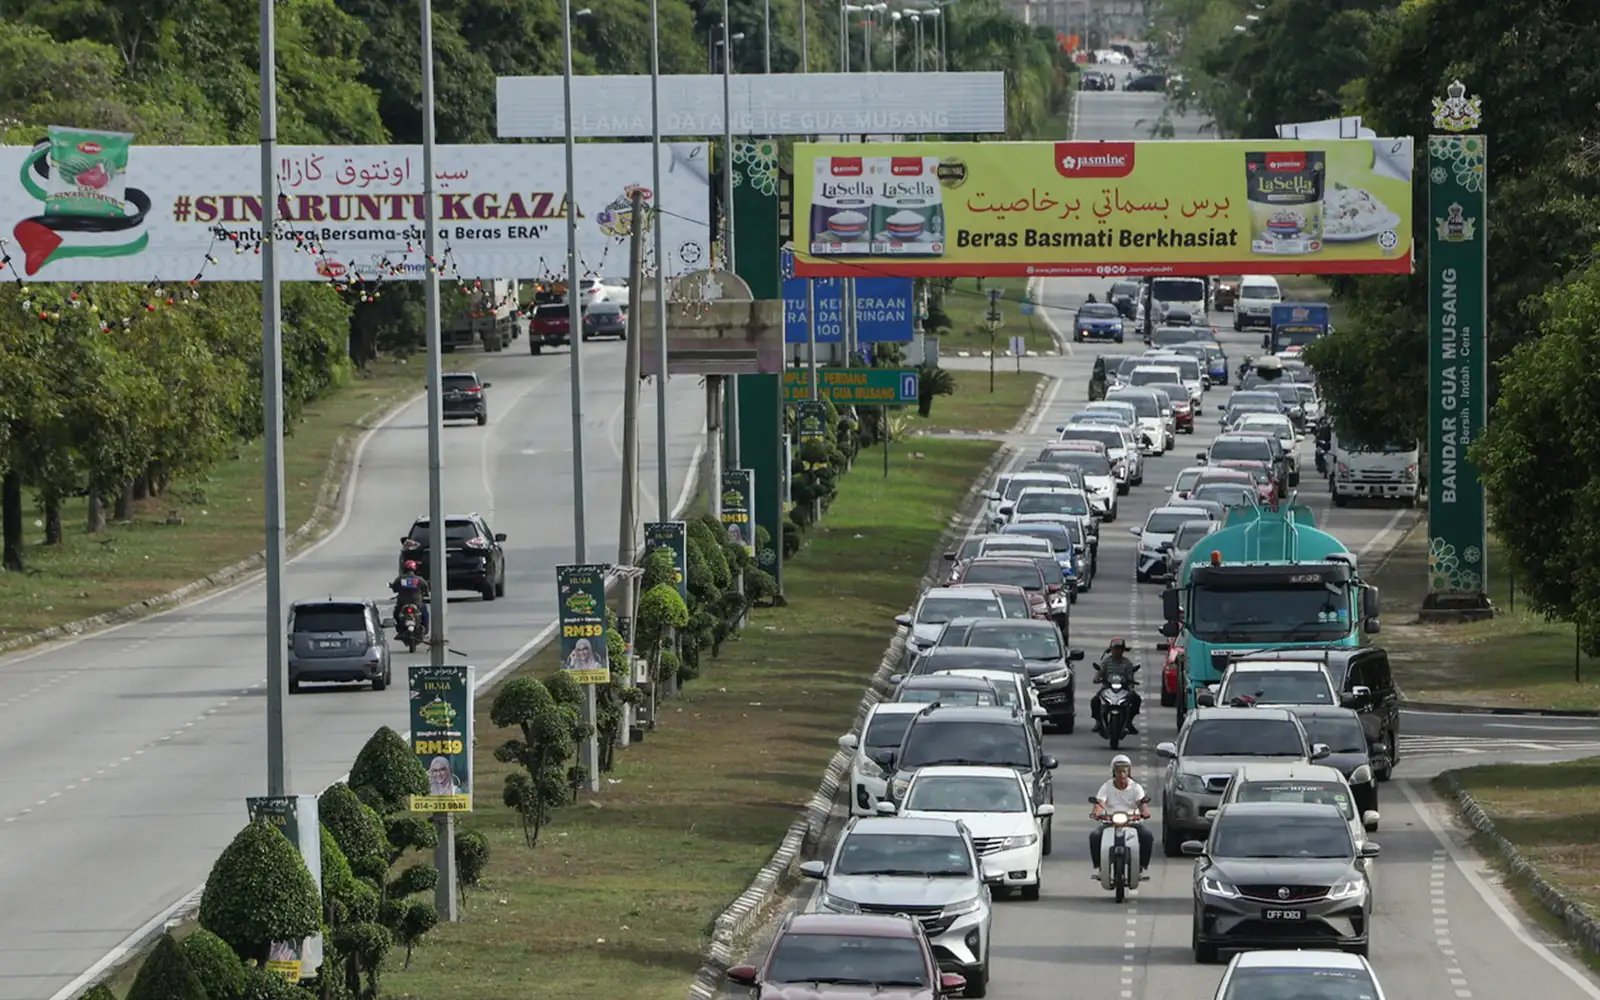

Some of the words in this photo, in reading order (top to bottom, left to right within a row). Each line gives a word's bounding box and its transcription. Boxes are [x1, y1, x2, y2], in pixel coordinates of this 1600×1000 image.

[553, 113, 645, 130] SELAMA
[763, 111, 790, 129] KE
[801, 111, 843, 130] GUA
[856, 110, 949, 129] MUSANG
[821, 181, 874, 198] LaSella
[880, 181, 934, 198] LaSella
[1180, 197, 1230, 219] برس
[321, 227, 448, 242] Bersama-saa
[455, 227, 501, 240] Beras
[956, 228, 1018, 248] Beras
[1024, 228, 1113, 248] Basmati
[1119, 228, 1238, 248] Berkhasiat
[1441, 267, 1458, 360] MUSANG
[817, 324, 841, 336] 100
[1460, 326, 1471, 357] Ceria
[1441, 365, 1458, 411] GUA
[1460, 366, 1471, 399] Indah
[1460, 406, 1471, 446] Bersih
[1441, 416, 1458, 504] BANDAR
[563, 624, 603, 637] RM39
[415, 739, 464, 755] RM39
